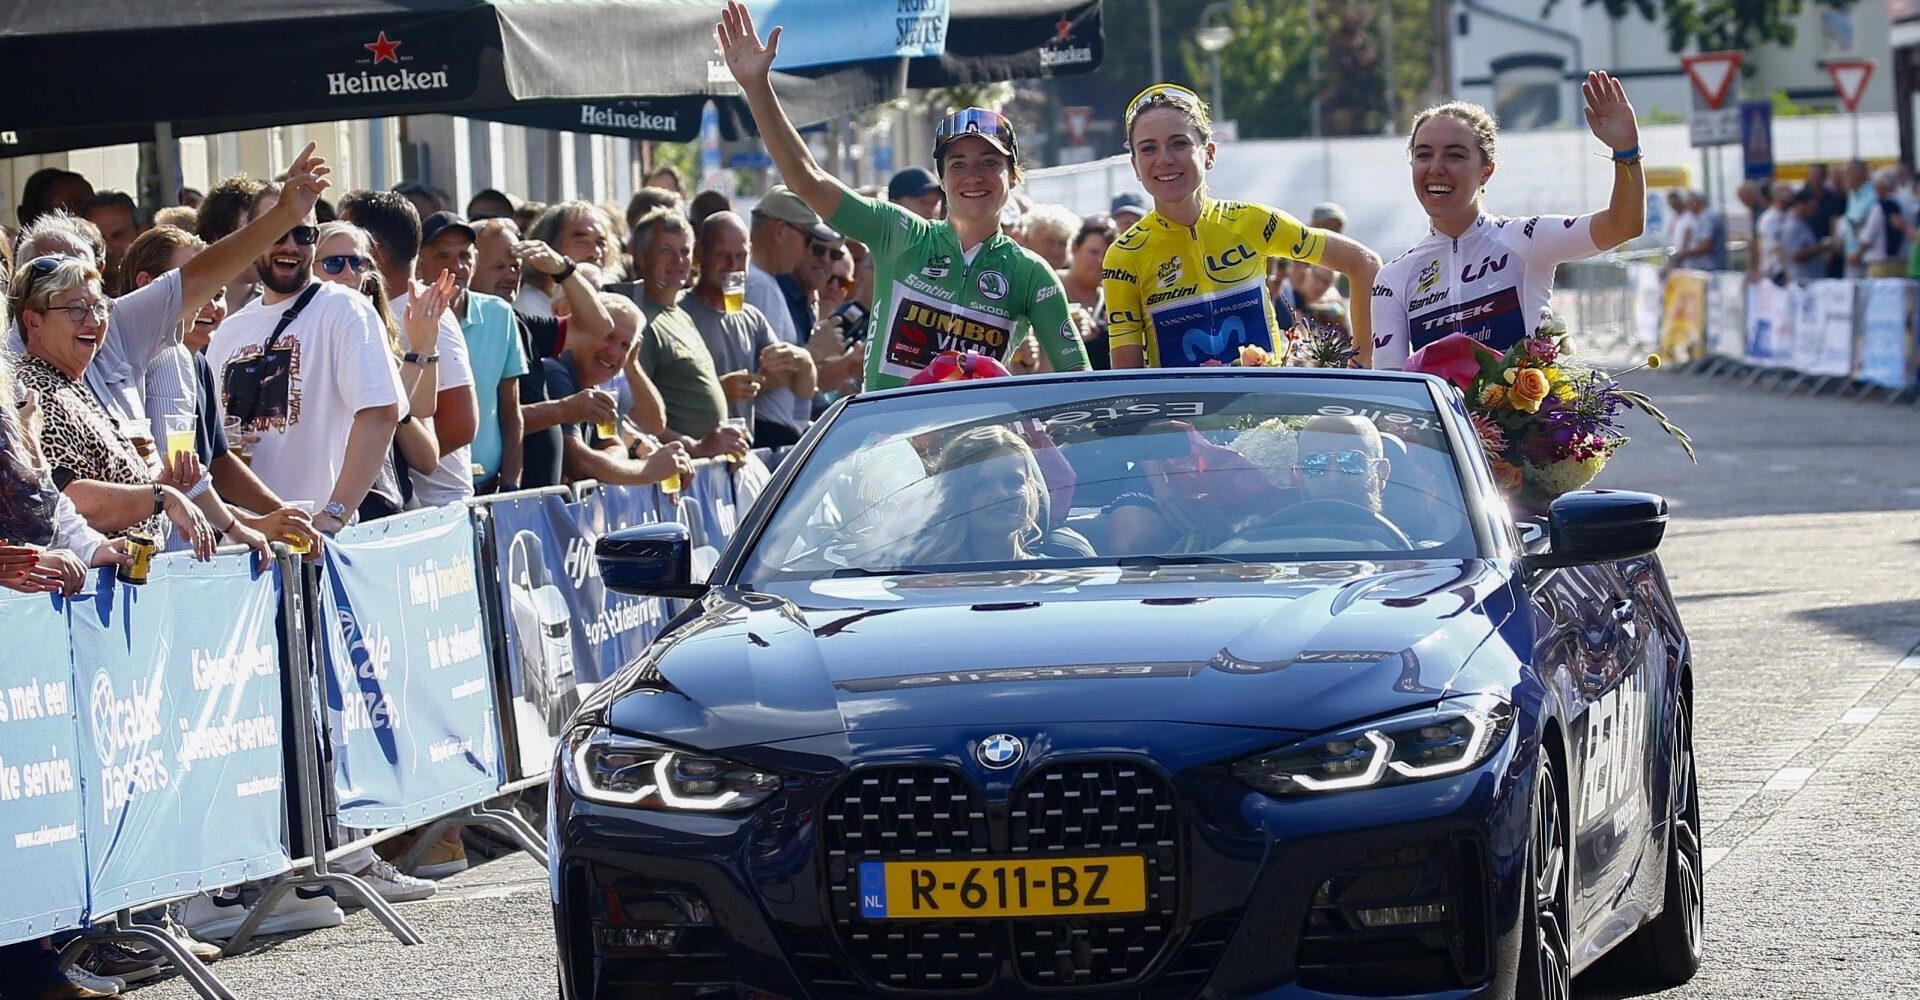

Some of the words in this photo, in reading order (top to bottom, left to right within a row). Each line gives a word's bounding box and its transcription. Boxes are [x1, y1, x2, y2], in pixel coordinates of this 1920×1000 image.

[327, 68, 448, 95] Heineken
[581, 104, 677, 132] Heineken
[1206, 244, 1257, 272] LCL
[905, 273, 956, 300] Santini
[1102, 268, 1137, 285] antini
[1147, 283, 1198, 306] Santini
[1408, 286, 1450, 313] Santini
[903, 304, 1004, 347] JUMBO
[1422, 301, 1495, 330] TREK
[8, 677, 44, 721] met
[0, 756, 20, 801] ke
[23, 744, 74, 799] service.
[910, 864, 1111, 910] R-611-BZ
[864, 895, 883, 908] NL
